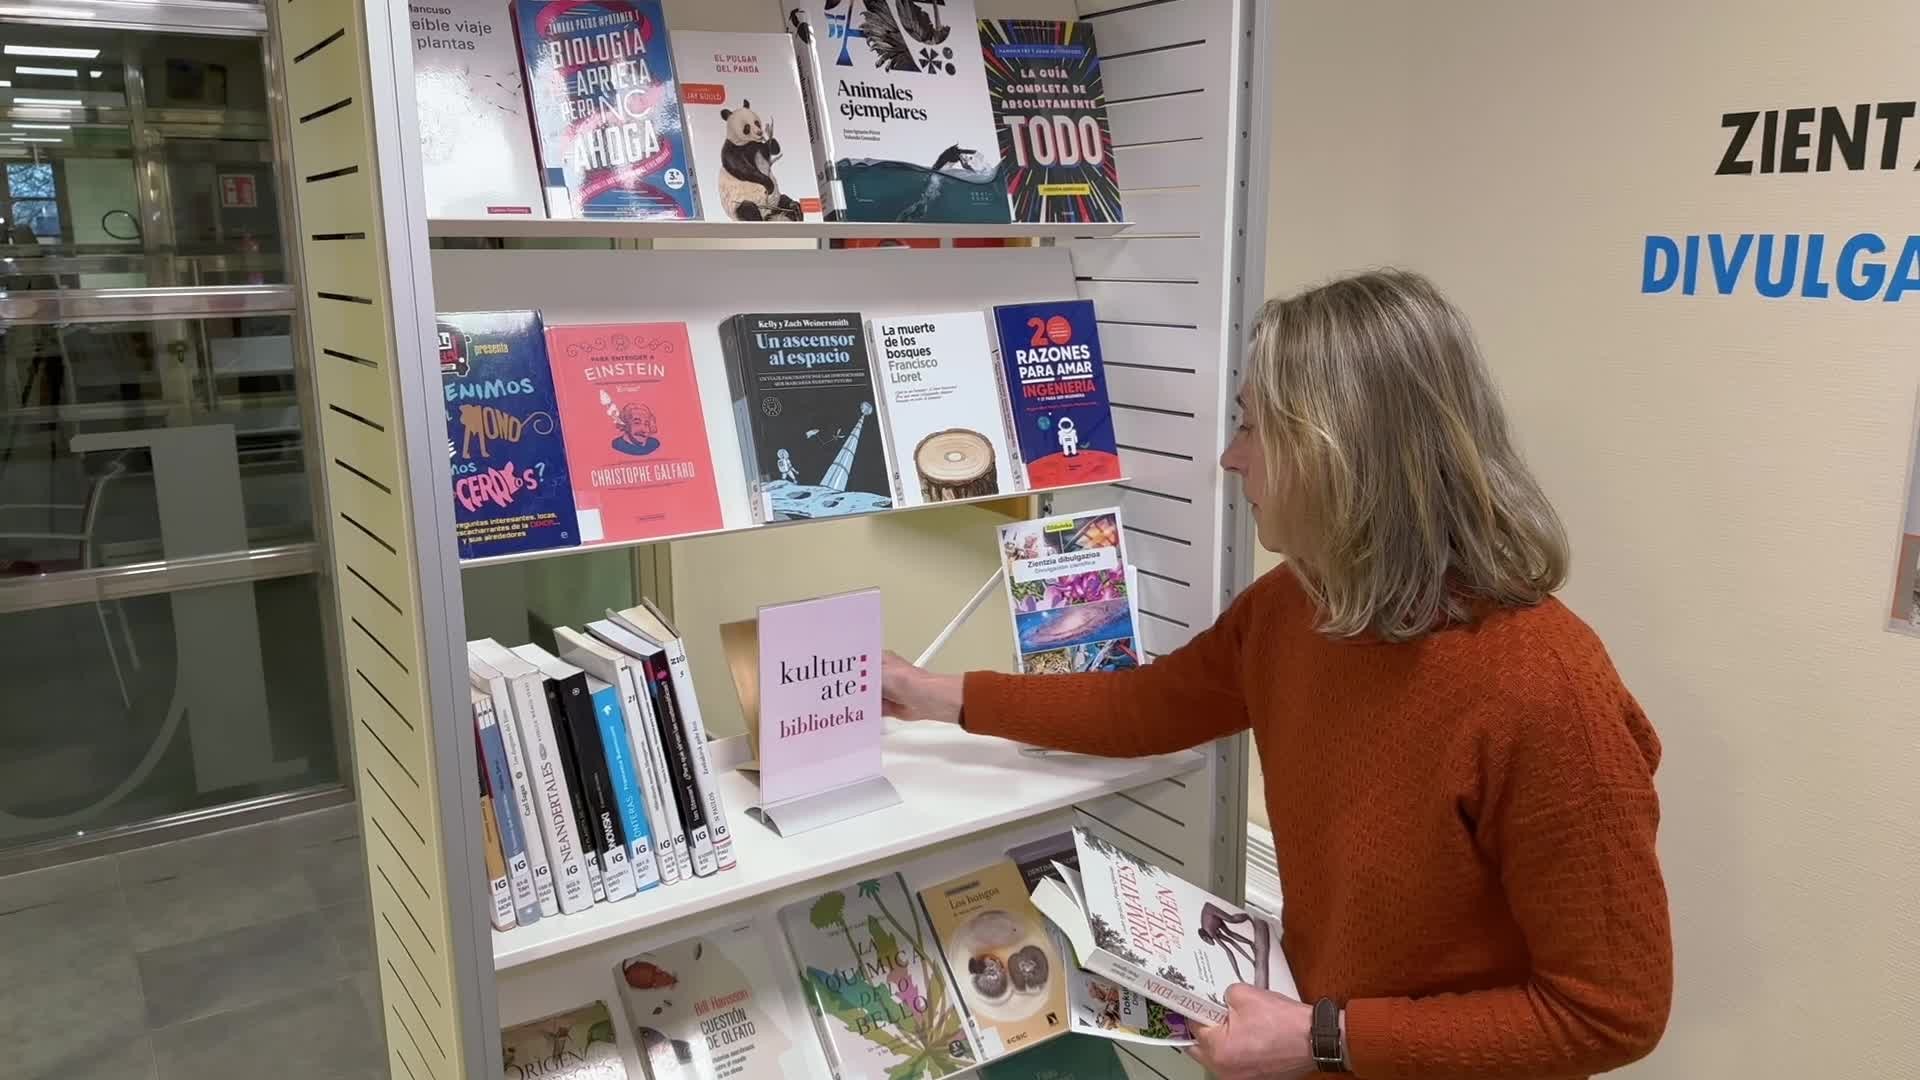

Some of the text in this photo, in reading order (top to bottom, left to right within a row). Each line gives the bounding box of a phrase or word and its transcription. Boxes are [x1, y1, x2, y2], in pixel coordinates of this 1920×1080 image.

[455, 20, 492, 36] viaje
[417, 36, 475, 50] plantas
[550, 24, 647, 69] BIOLOGÍA
[714, 54, 758, 64] EL PULGAR
[716, 64, 759, 74] DEL PANDA
[1021, 68, 1036, 79] LA
[577, 58, 651, 97] APRIETA
[837, 79, 913, 102] Animales
[1006, 84, 1087, 94] COMPLETA DE
[561, 98, 594, 122] PERO
[839, 101, 928, 123] ejemplares
[1001, 99, 1097, 110] ABSOLUTAMENTE
[573, 119, 661, 172] AHOGA
[1002, 114, 1103, 168] TODO
[1714, 101, 1920, 175] ZIENT
[1641, 233, 1920, 302] DIVULGA
[758, 318, 849, 329] Kelly y Zach Weinersmith
[882, 322, 936, 336] La muerte
[755, 333, 856, 349] Un ascensor
[884, 335, 916, 347] de los
[769, 348, 850, 368] al espacio
[886, 345, 932, 360] bosques
[1015, 345, 1090, 366] RAZONES
[584, 362, 665, 381] EINSTEIN
[888, 357, 938, 372] Francisco
[1019, 361, 1093, 379] PARA AMAR
[891, 371, 923, 384] Lloret
[591, 461, 696, 487] CHRISTOPHE GALFARD
[1027, 557, 1057, 568] Zientzia
[780, 655, 857, 685] kultur
[820, 679, 857, 701] ate
[780, 706, 864, 739] biblioteka
[541, 761, 574, 864] NEANDERTALES
[695, 831, 707, 842] IG
[715, 825, 726, 836] IG
[660, 839, 671, 850] IG
[673, 834, 685, 845] IG
[636, 844, 647, 855] IG
[514, 860, 526, 872] IG
[612, 853, 624, 864] IG
[535, 866, 548, 877] IG
[566, 865, 578, 876] IG
[494, 879, 507, 891] IG
[1118, 865, 1153, 955] PRIMATES
[1145, 906, 1172, 955] ESTE
[700, 1007, 747, 1035] CUESTIÓN
[706, 1021, 756, 1050] DE OLFATO
